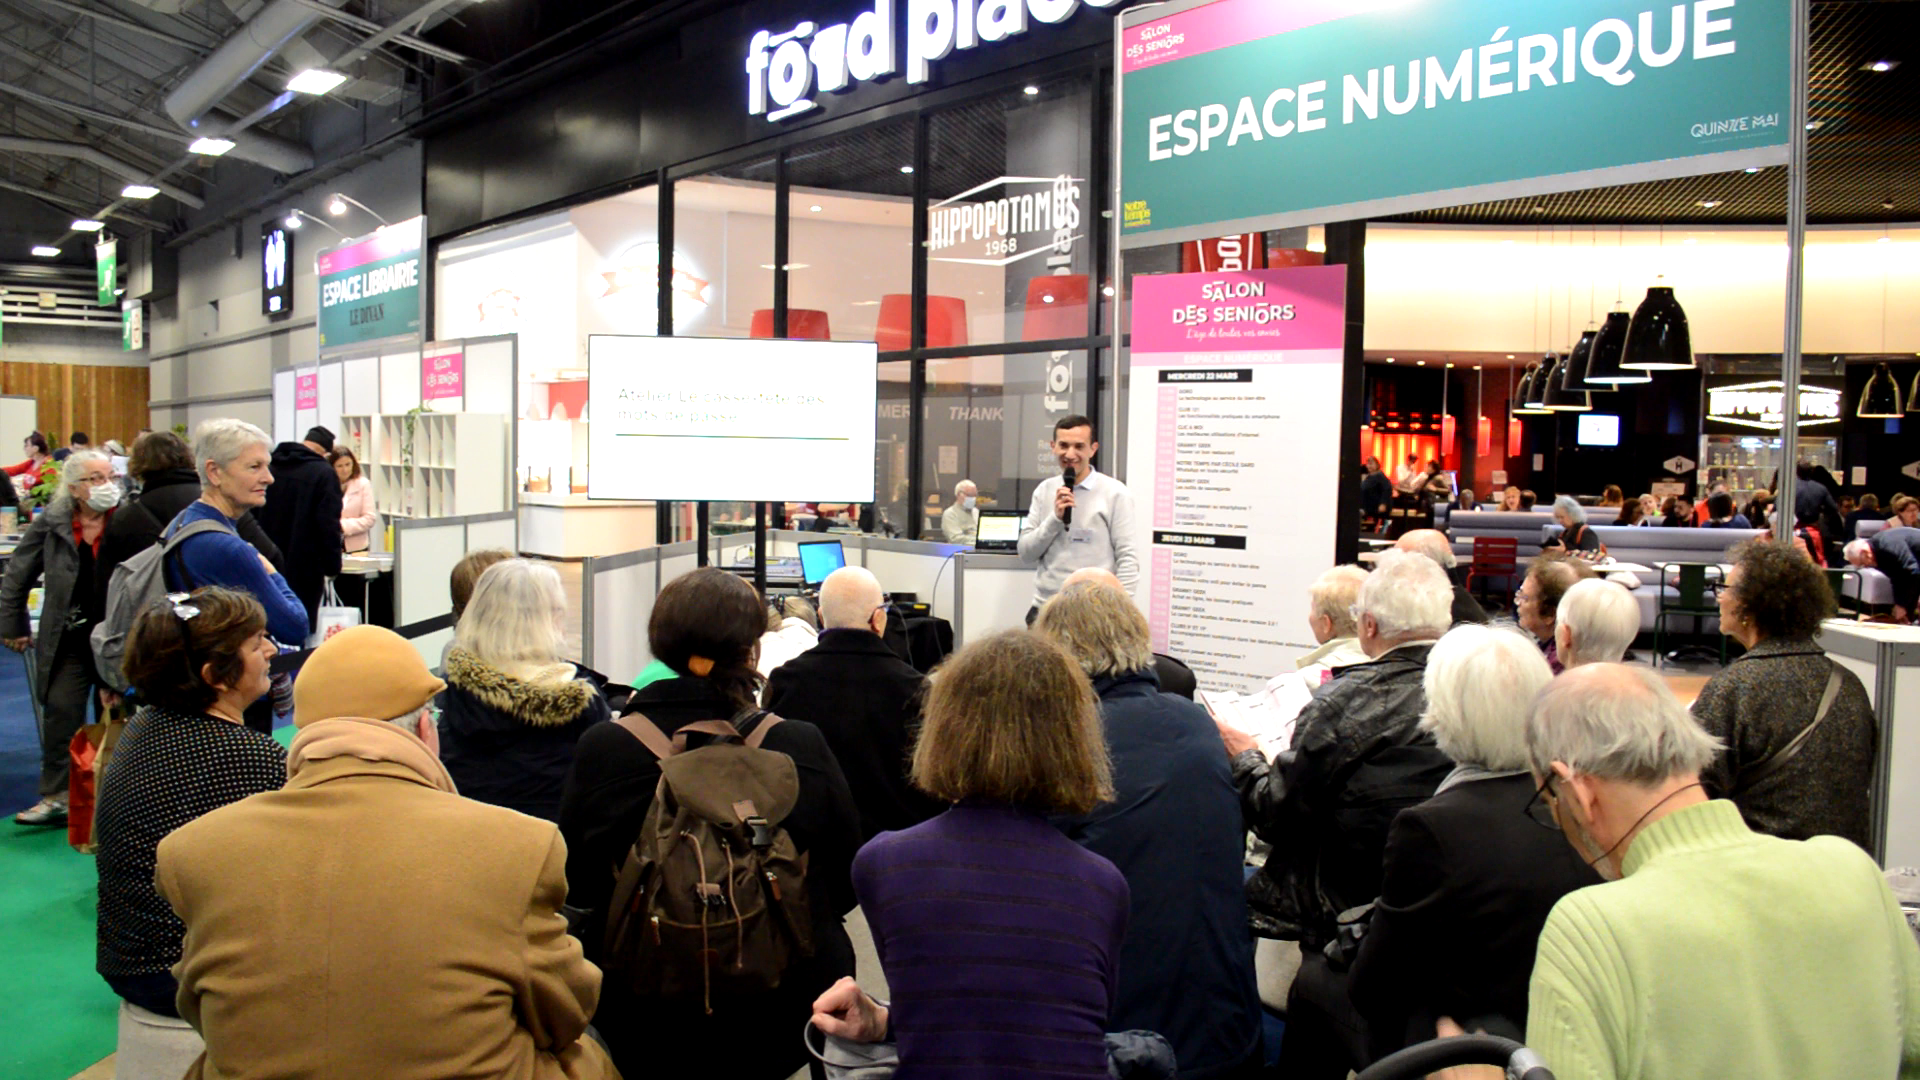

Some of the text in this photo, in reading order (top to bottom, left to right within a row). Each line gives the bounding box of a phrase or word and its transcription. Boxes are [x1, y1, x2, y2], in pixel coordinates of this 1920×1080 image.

[1141, 23, 1171, 40] SALON
[906, 0, 1121, 84] plac
[1126, 44, 1144, 58] DES
[1146, 33, 1185, 52] SENIORS
[1150, 0, 1736, 162] ESPACE NUMÉRIQUE
[1752, 113, 1779, 129] MAI
[931, 185, 1080, 250] HIPPOPOTAMUS
[985, 238, 1018, 256] 1968
[323, 274, 361, 308] ESPACE
[362, 259, 419, 298] LIBRAIRIE
[1202, 280, 1266, 302] SALON
[350, 309, 359, 326] LE
[1172, 302, 1296, 326] DES SENIORS
[1184, 354, 1221, 364] ESPACE
[1216, 372, 1238, 380] MARS
[618, 388, 673, 402] Atelier
[680, 391, 698, 402] Le
[949, 406, 1004, 421] THANK
[1193, 536, 1216, 545] MARS
